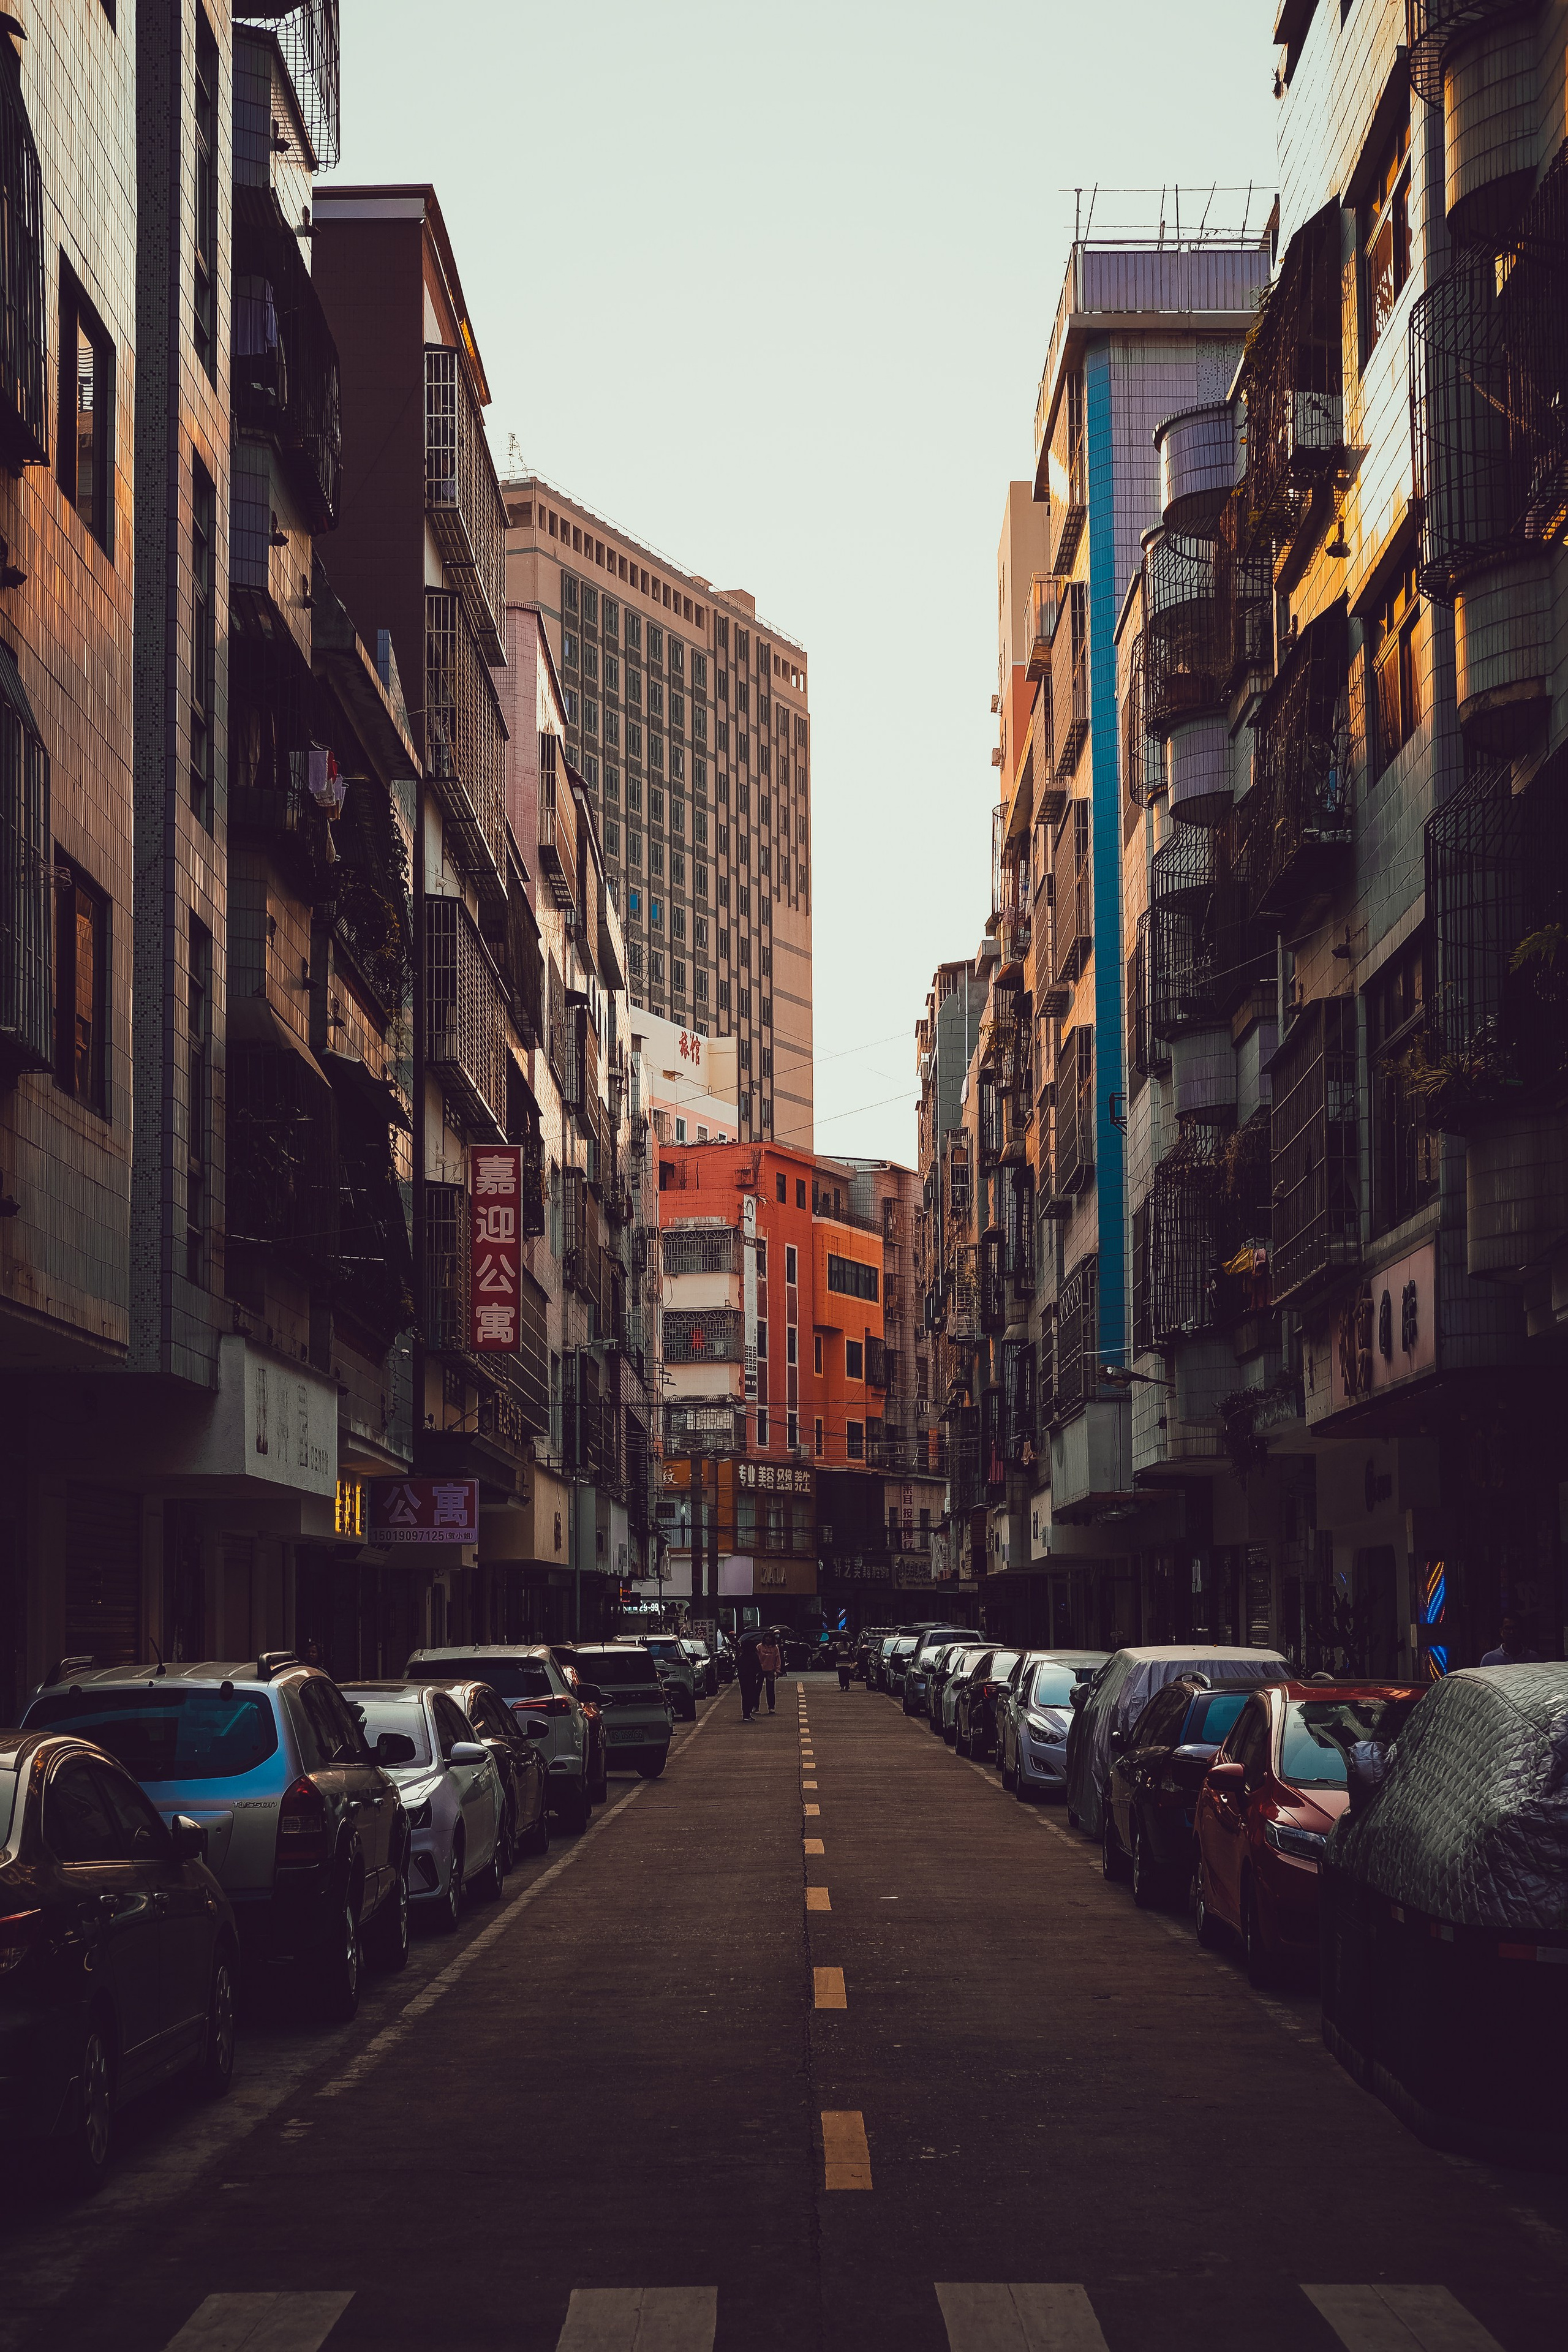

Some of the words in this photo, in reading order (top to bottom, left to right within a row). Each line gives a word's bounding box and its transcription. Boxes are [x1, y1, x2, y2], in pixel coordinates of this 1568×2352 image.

[679, 1031, 701, 1066] 旅馆
[475, 1155, 516, 1344] 嘉迎公寓
[383, 1483, 469, 1527] 公寓
